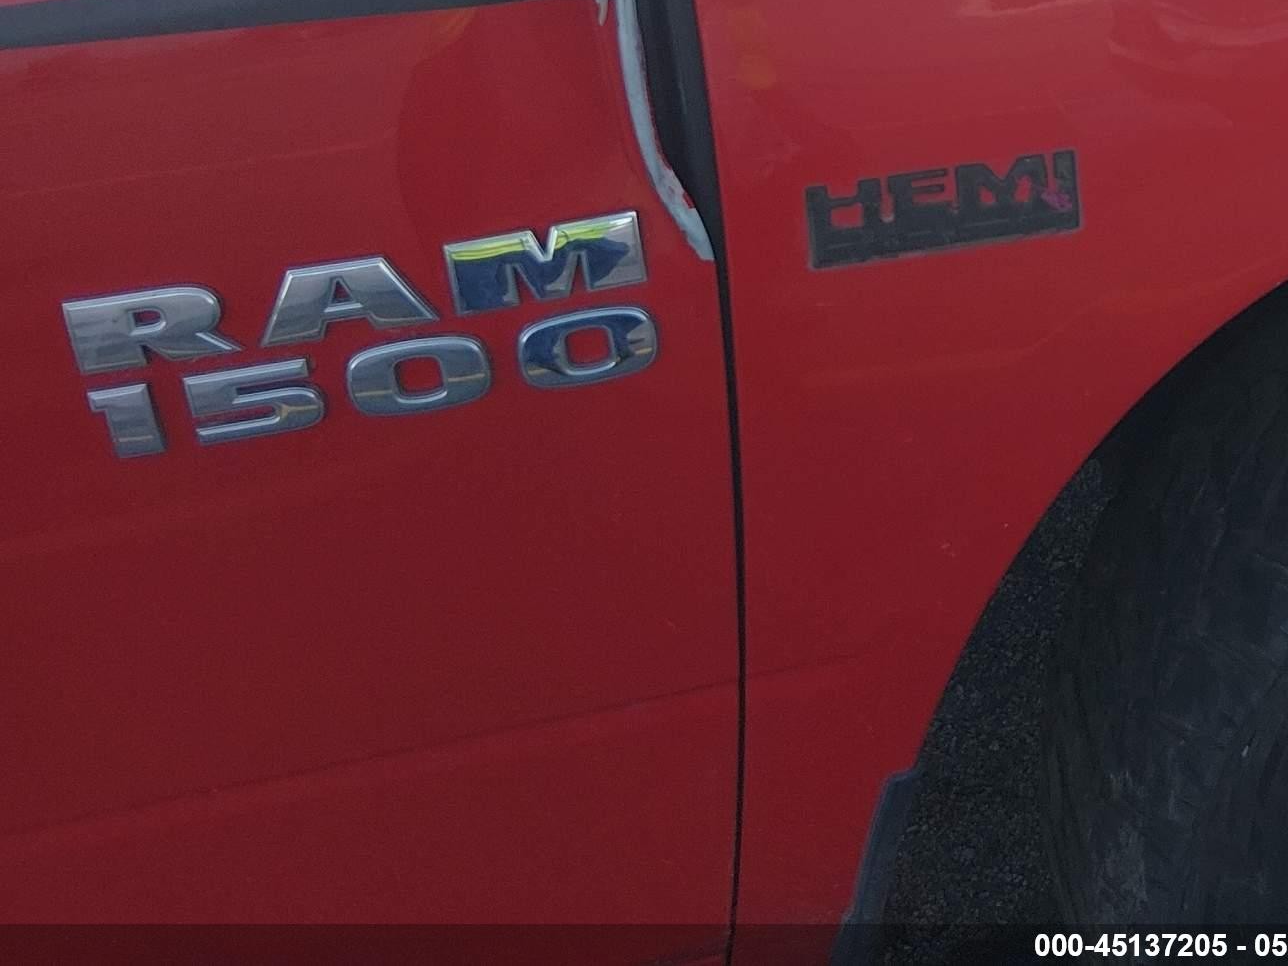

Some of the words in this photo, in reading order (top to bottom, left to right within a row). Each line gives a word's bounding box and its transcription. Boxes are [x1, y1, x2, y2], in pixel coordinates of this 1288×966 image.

[805, 149, 1081, 268] HEMI
[62, 211, 648, 373] RAM
[87, 306, 658, 458] 1500
